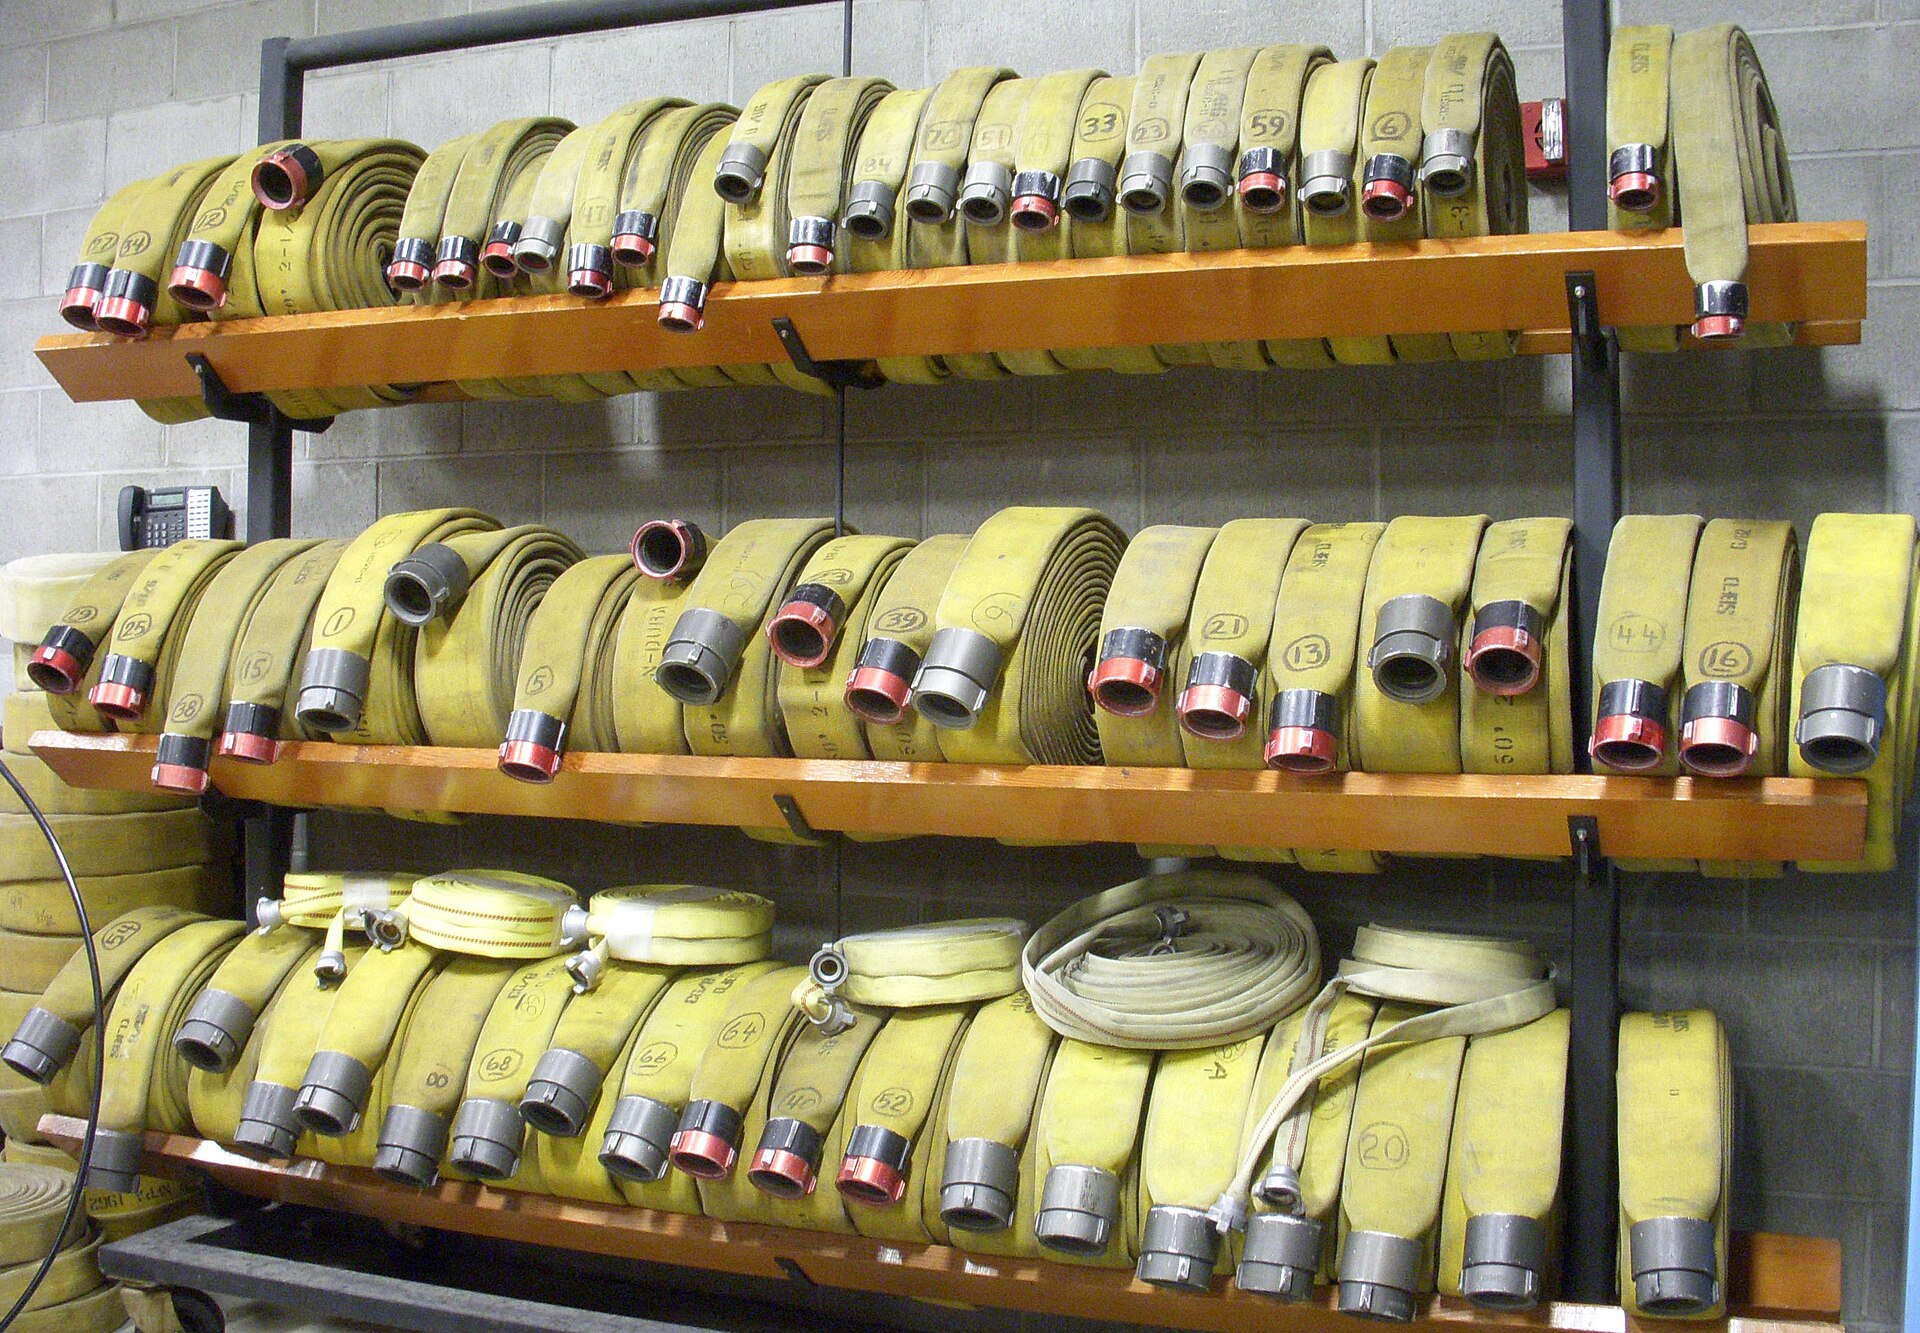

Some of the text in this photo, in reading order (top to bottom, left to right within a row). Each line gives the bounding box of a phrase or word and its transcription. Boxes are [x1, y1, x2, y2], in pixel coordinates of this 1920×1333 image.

[1083, 112, 1118, 137] 33
[1250, 114, 1287, 138] 59
[120, 620, 149, 640] 25
[886, 612, 919, 629] 39
[1209, 617, 1241, 635] 21
[1614, 625, 1659, 646] 44
[1293, 643, 1321, 665] 13
[105, 923, 141, 948] 54
[722, 1019, 758, 1042] 64
[881, 1091, 907, 1109] 52
[1360, 1131, 1407, 1163] 20
